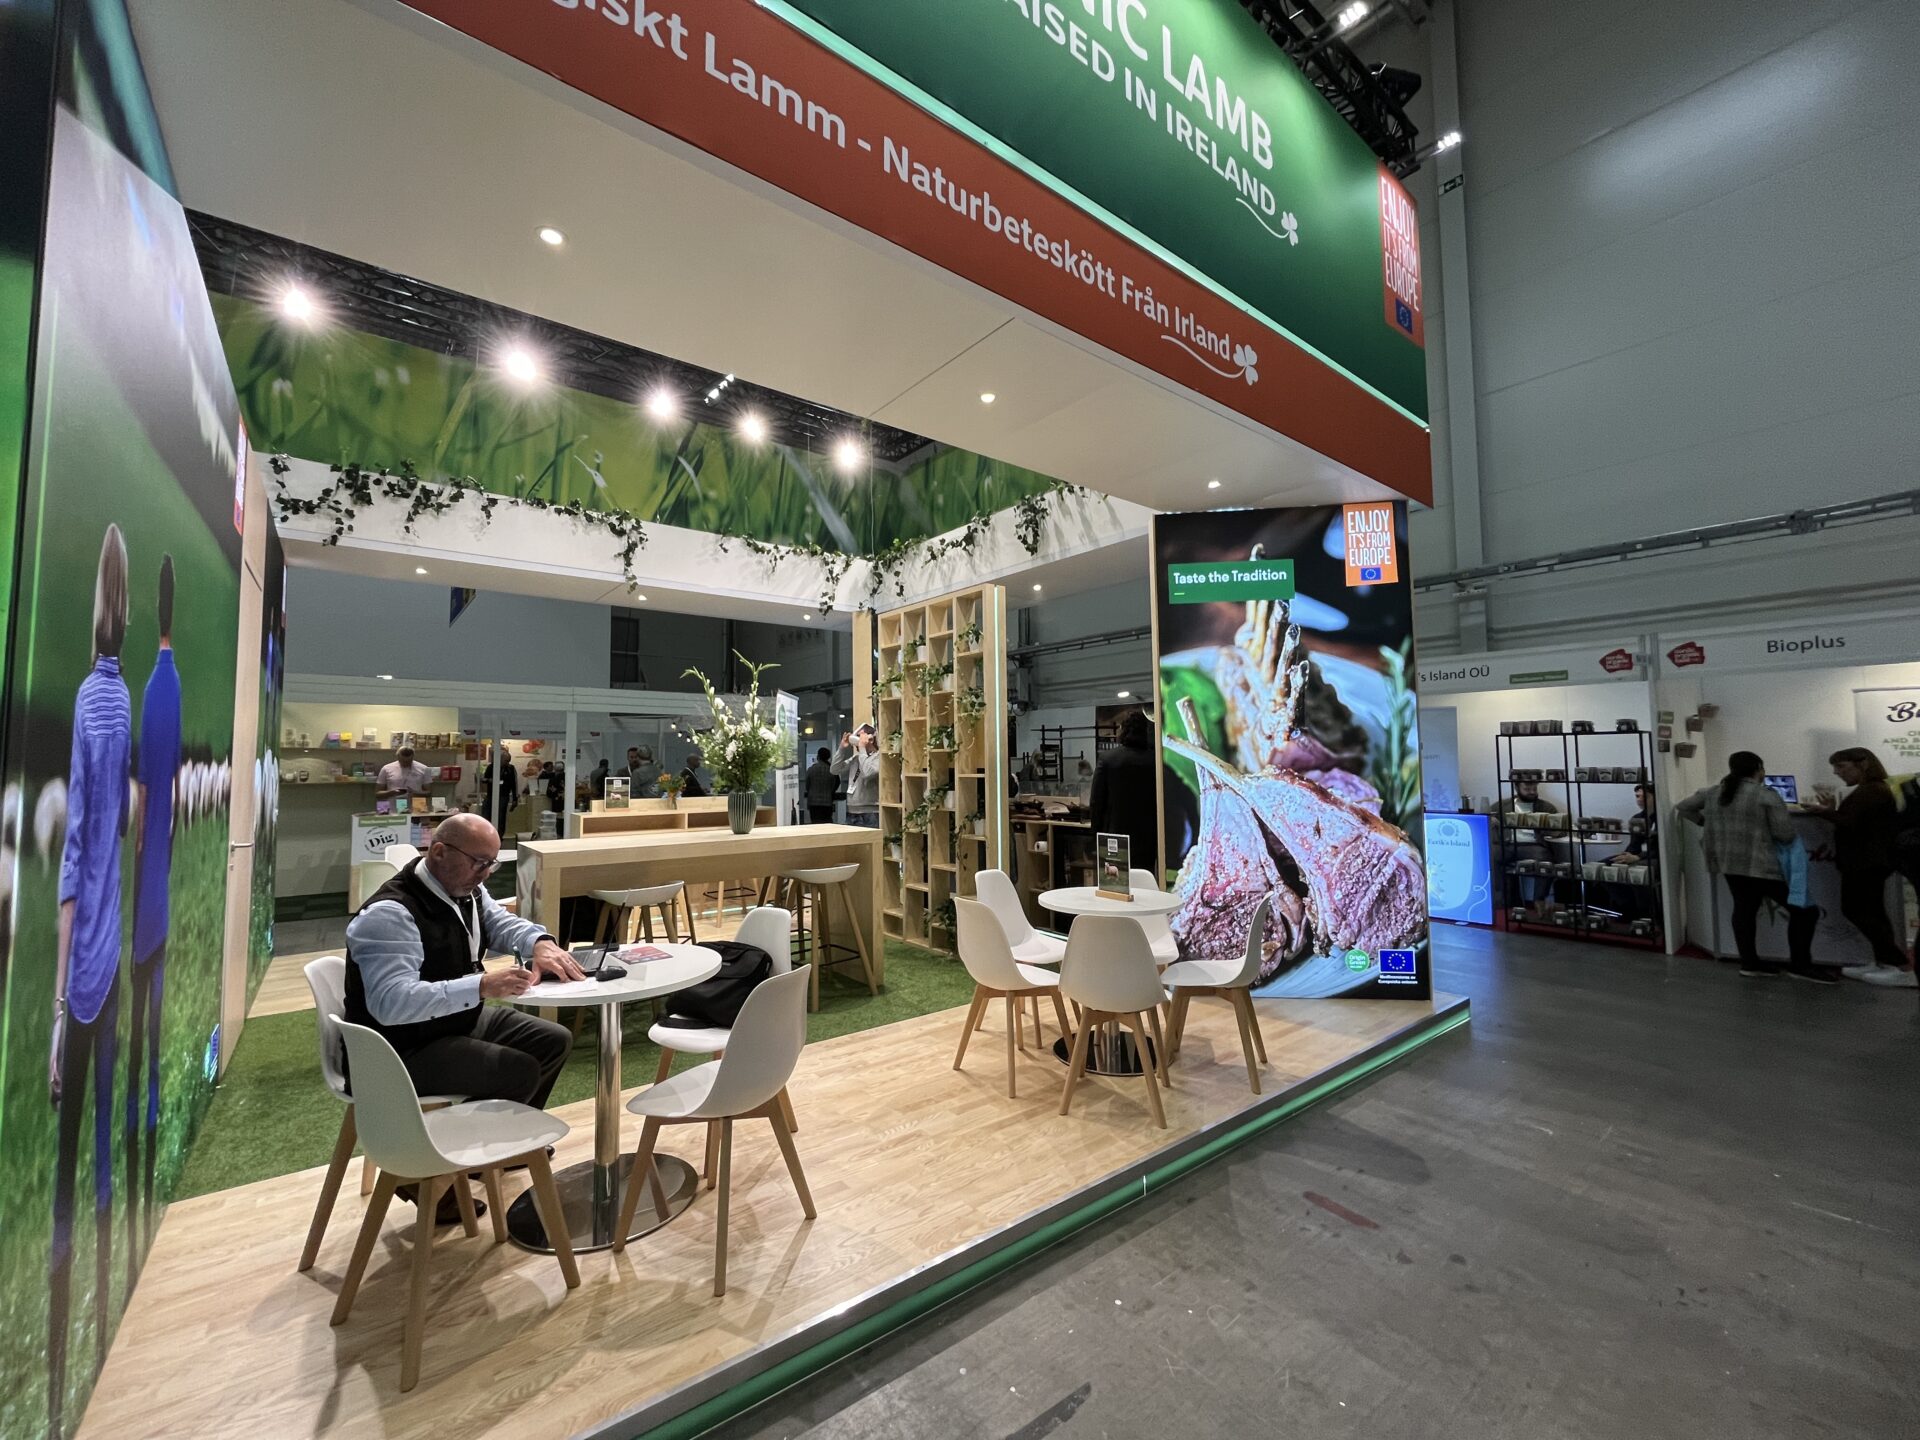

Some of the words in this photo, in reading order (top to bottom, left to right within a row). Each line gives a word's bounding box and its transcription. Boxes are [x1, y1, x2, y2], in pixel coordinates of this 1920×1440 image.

[1162, 24, 1273, 170] LAMB
[1125, 66, 1157, 122] IN
[1166, 102, 1276, 216] IRELAND
[705, 31, 846, 149] Lamm
[857, 137, 871, 152] -
[883, 135, 1116, 298] Naturbeteskött
[1121, 275, 1169, 328] Från
[1175, 306, 1230, 361] Irland
[1381, 175, 1416, 249] ENJOY
[1383, 221, 1398, 260] IT'S
[1398, 235, 1418, 278] FROM
[1384, 251, 1420, 312] EUROPE
[1347, 509, 1390, 533] ENJOY
[1348, 533, 1365, 549] IT'S
[1366, 531, 1391, 548] FROM
[1349, 547, 1392, 567] EUROPE
[1173, 572, 1206, 585] Taste
[1208, 570, 1230, 583] the
[1231, 568, 1287, 582] Tradition
[1766, 634, 1846, 654] Bioplus
[1429, 667, 1466, 681] Island
[1469, 664, 1490, 678] OÜ
[368, 833, 395, 848] Dig
